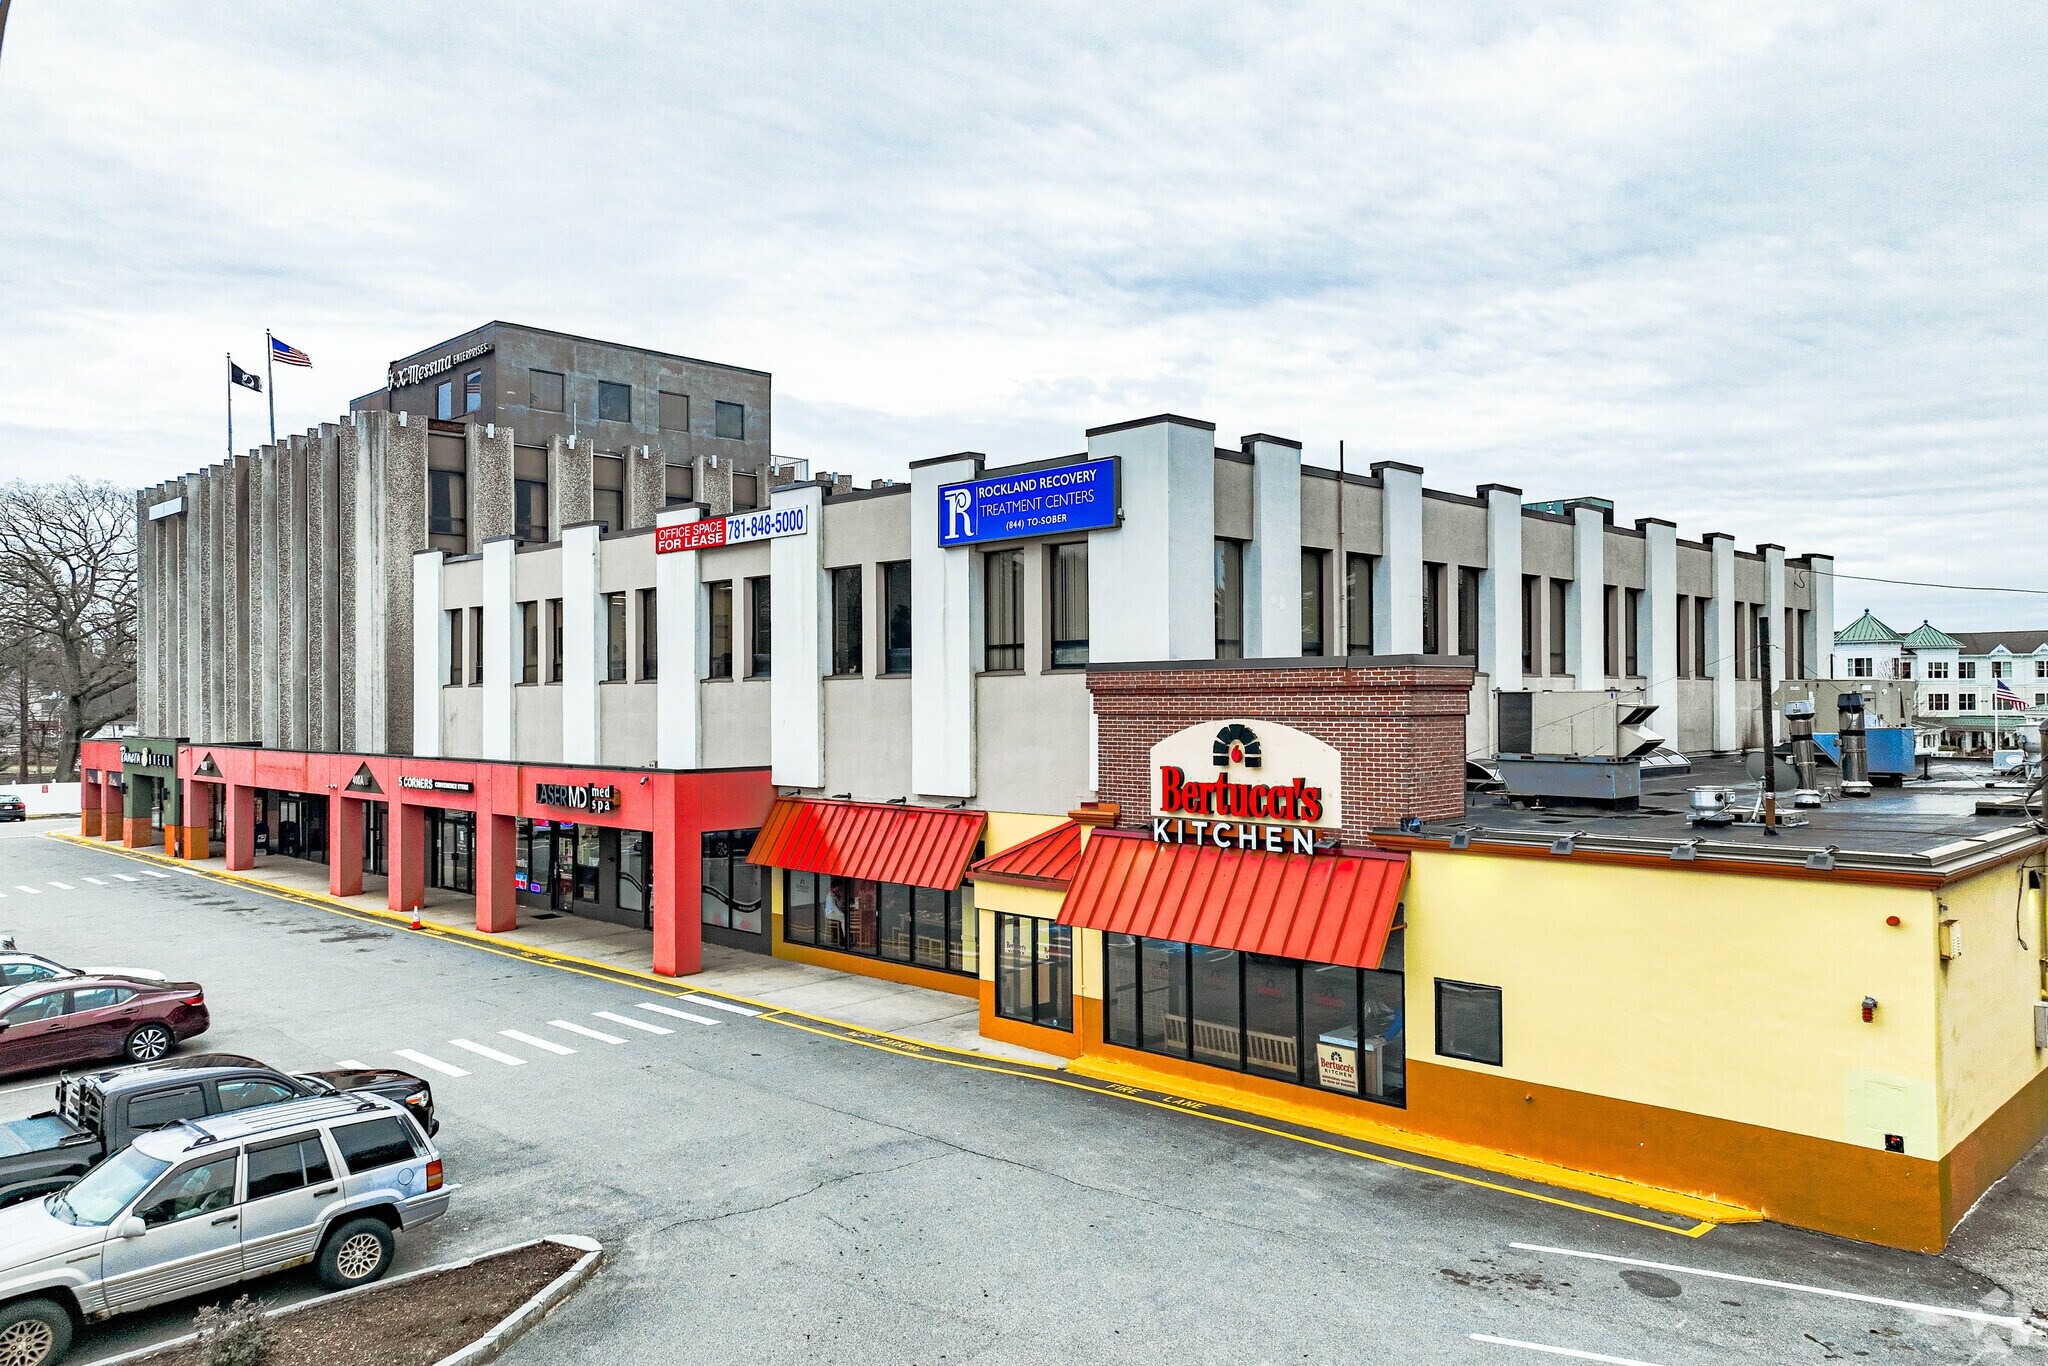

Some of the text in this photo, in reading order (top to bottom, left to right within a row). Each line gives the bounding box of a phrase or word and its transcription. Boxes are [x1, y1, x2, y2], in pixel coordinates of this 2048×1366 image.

[453, 342, 488, 364] ENTERPRISES
[978, 469, 1097, 499] ROCKLAND RECOVERY
[980, 489, 1094, 517] TREATMENT CENTERS
[658, 520, 722, 541] OFFICE SPACE
[727, 508, 803, 540] 781-848-5000
[1005, 513, 1067, 531] (844) TO-SOBER
[658, 532, 723, 552] FOR LEASE
[398, 776, 403, 787] 5
[403, 777, 433, 789] CORNERS
[591, 785, 610, 798] med
[1160, 765, 1323, 822] Bertucci's
[591, 800, 610, 813] spa
[1153, 818, 1314, 855] KITCHEN
[1320, 1057, 1355, 1073] Bertucci's
[1324, 1068, 1352, 1078] KITCHEN
[1105, 1083, 1207, 1110] FIRE LANE
